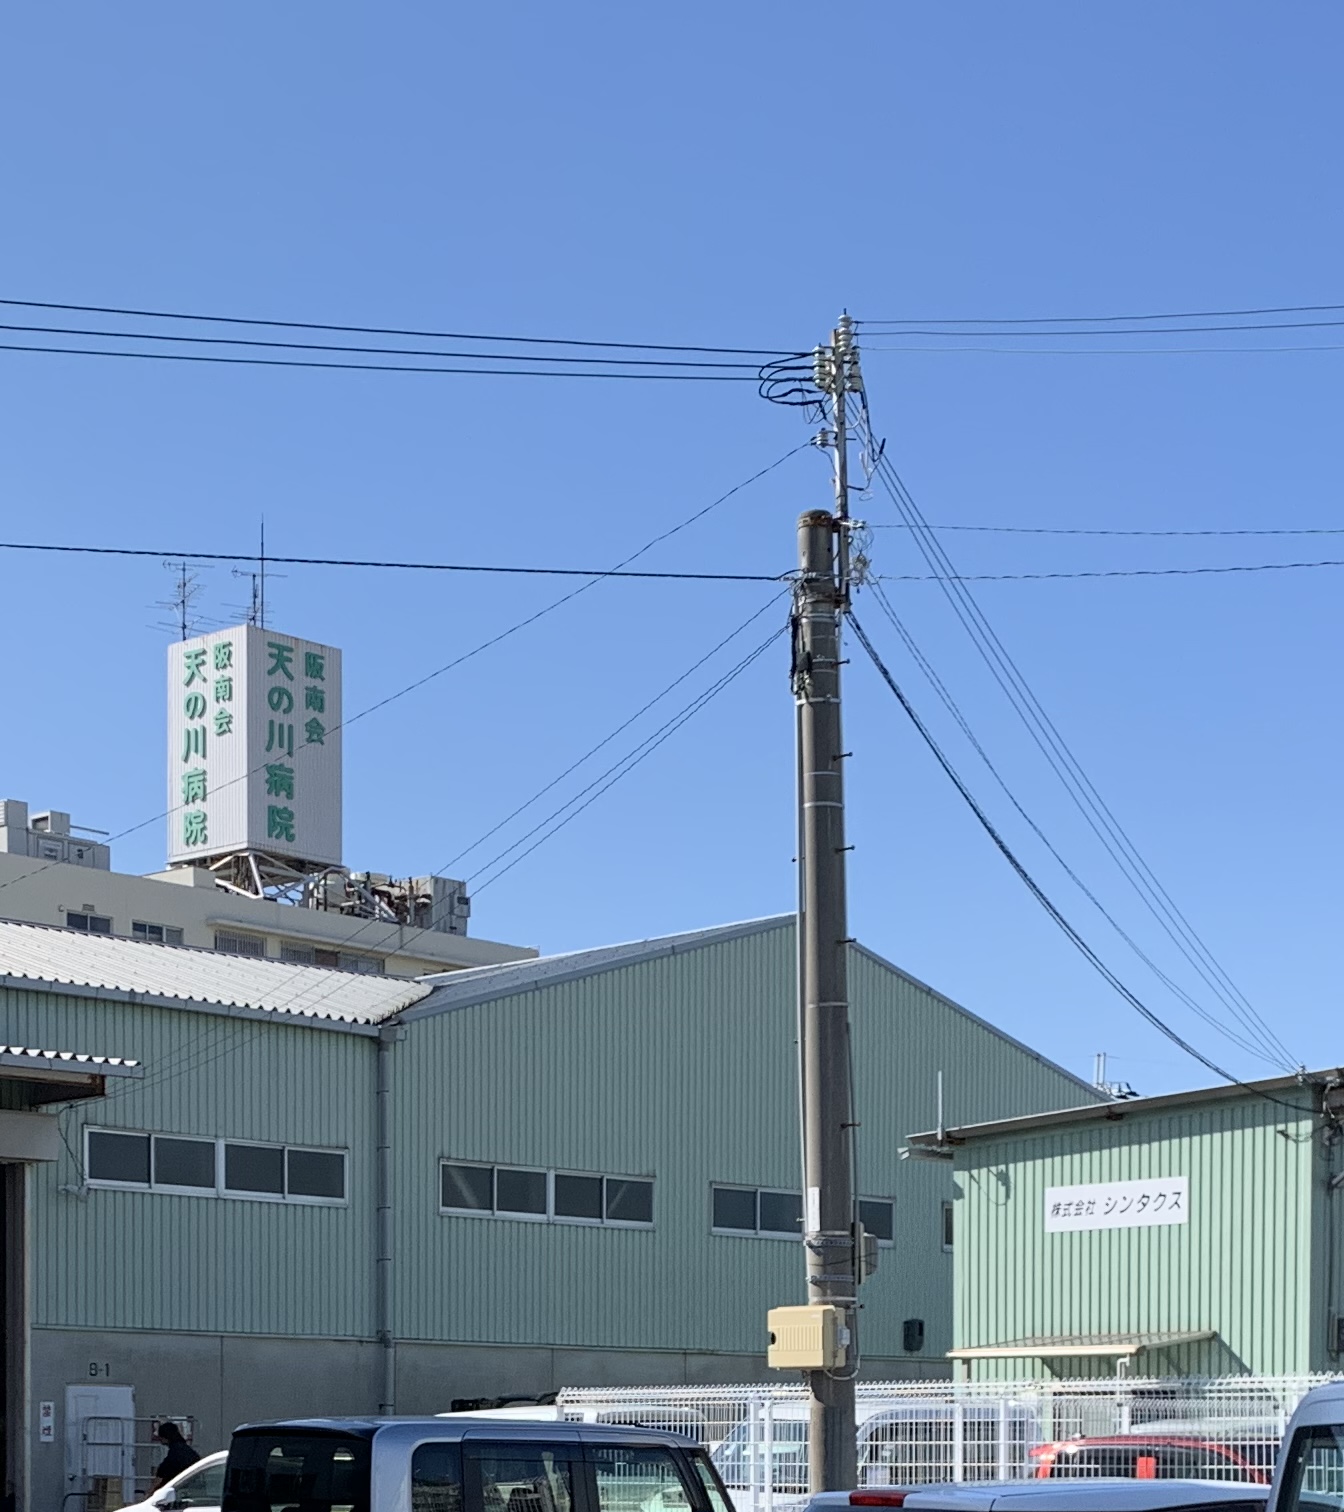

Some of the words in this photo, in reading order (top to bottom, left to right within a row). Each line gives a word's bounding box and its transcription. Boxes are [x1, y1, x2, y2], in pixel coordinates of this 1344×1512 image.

[181, 648, 208, 846] 天の川病院
[213, 641, 233, 736] 阪南会
[265, 641, 295, 843] 天の川病院
[304, 651, 326, 745] 阪南会
